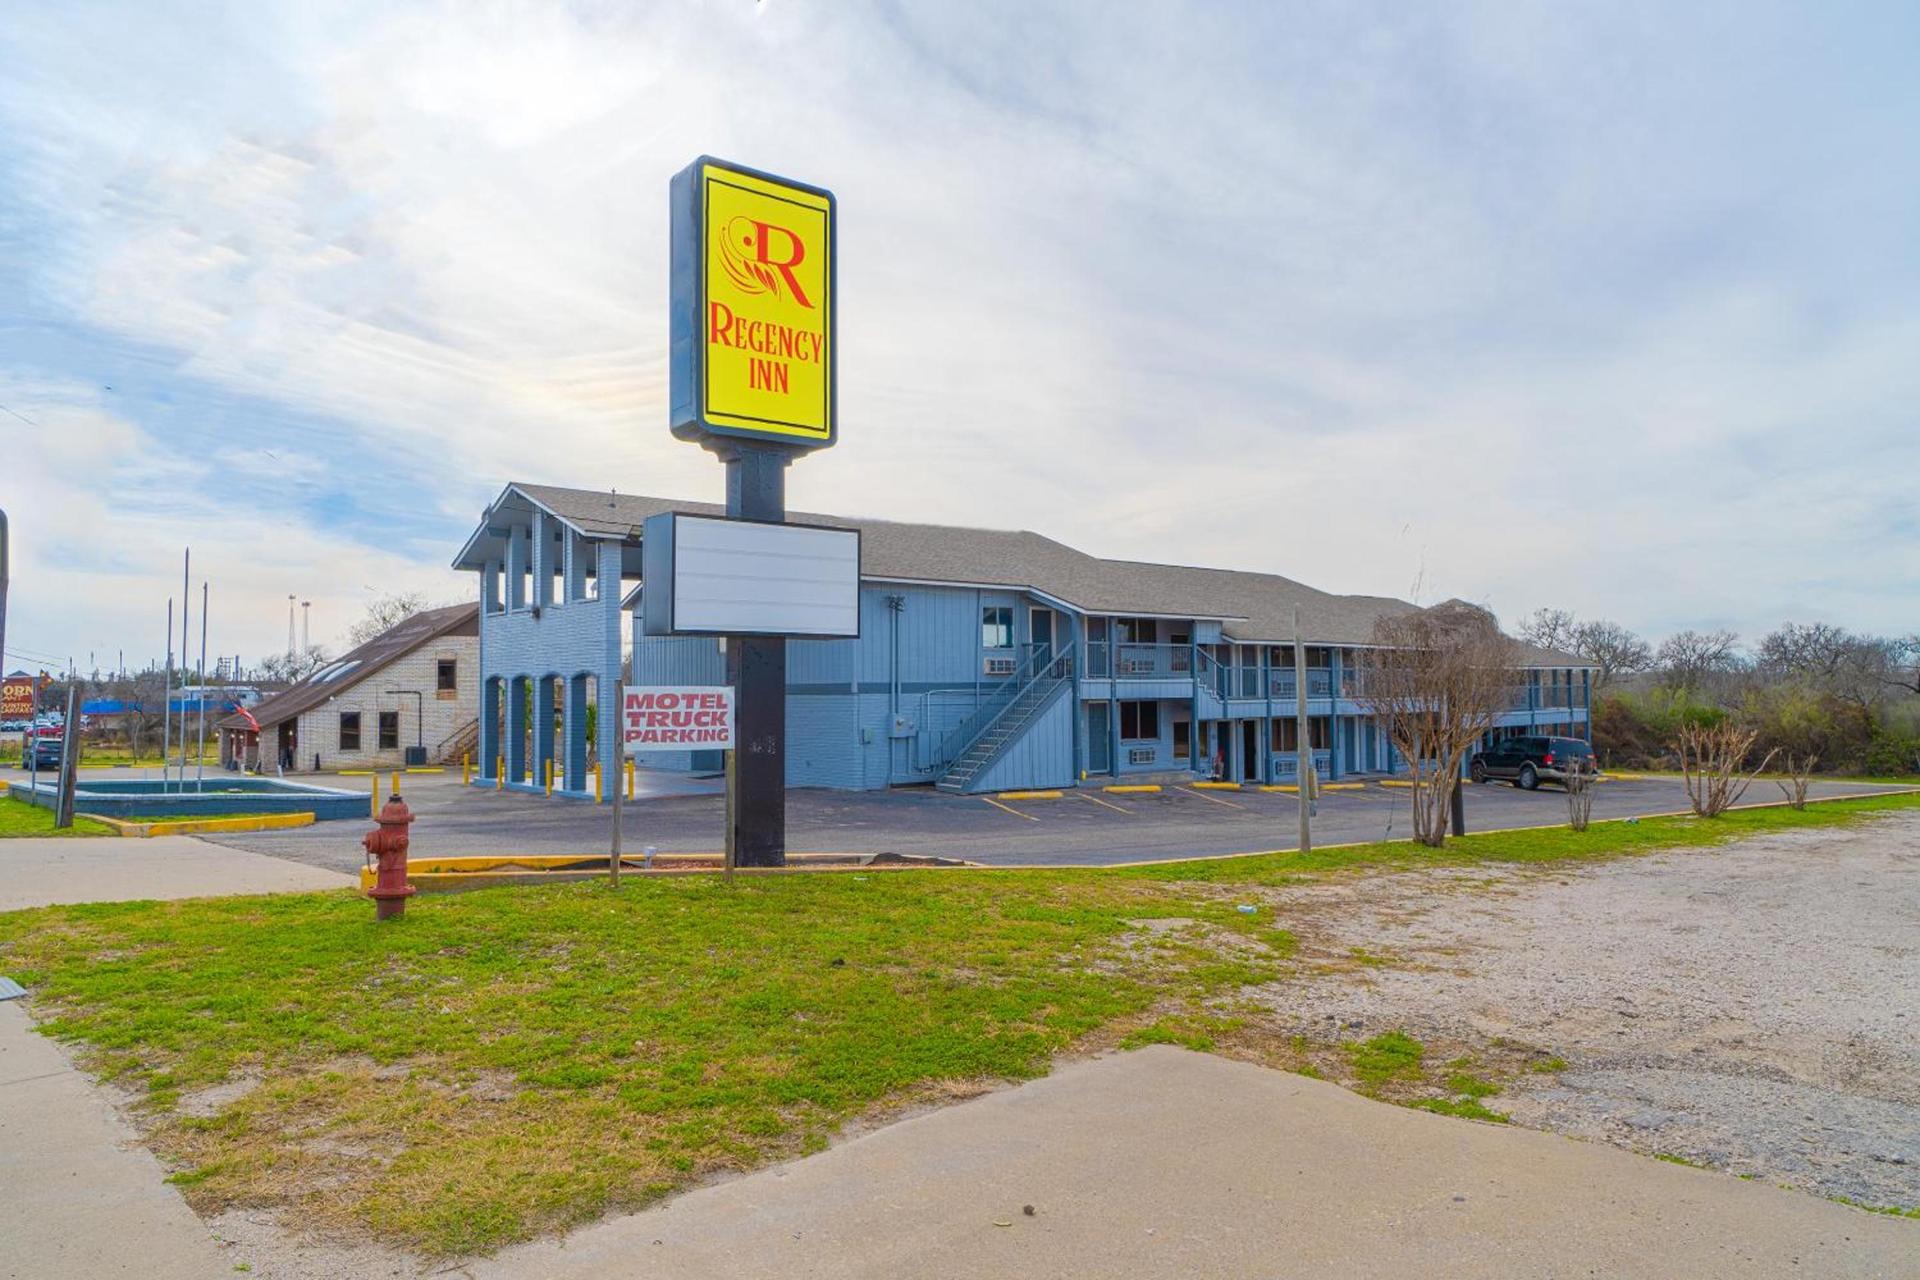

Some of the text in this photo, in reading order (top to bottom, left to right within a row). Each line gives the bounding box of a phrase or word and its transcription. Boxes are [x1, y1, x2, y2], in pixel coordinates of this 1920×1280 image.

[749, 358, 789, 395] INN
[625, 693, 728, 709] MOTEL
[626, 711, 728, 728] TRUCK
[625, 728, 729, 743] PARKING
